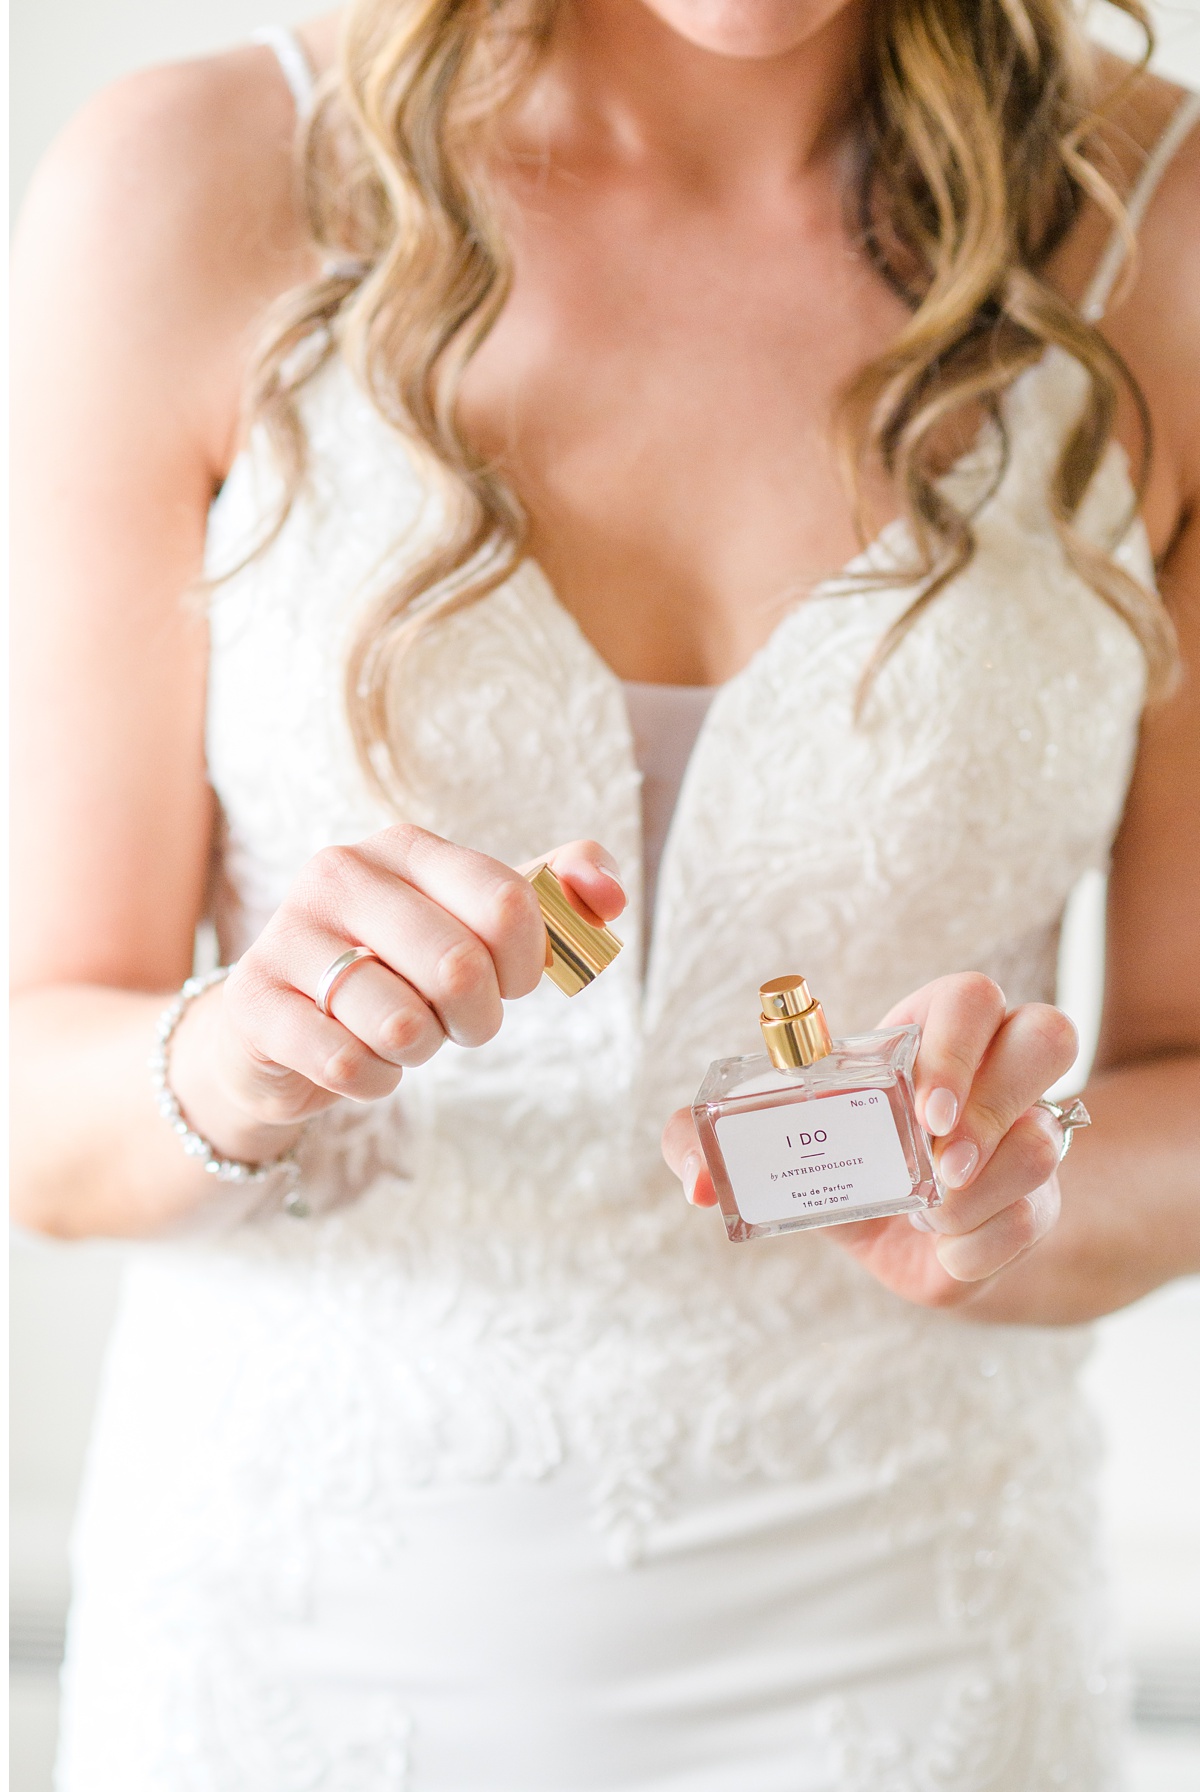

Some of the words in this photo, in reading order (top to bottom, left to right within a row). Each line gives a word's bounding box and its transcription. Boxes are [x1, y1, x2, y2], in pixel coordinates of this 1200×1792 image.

[850, 1099, 866, 1108] No.
[786, 1136, 791, 1148] I
[800, 1130, 827, 1146] DO
[770, 1173, 779, 1182] by
[782, 1158, 864, 1178] ANTHROPOLOGIE
[792, 1190, 807, 1199] Eau
[823, 1182, 854, 1193] Parfum
